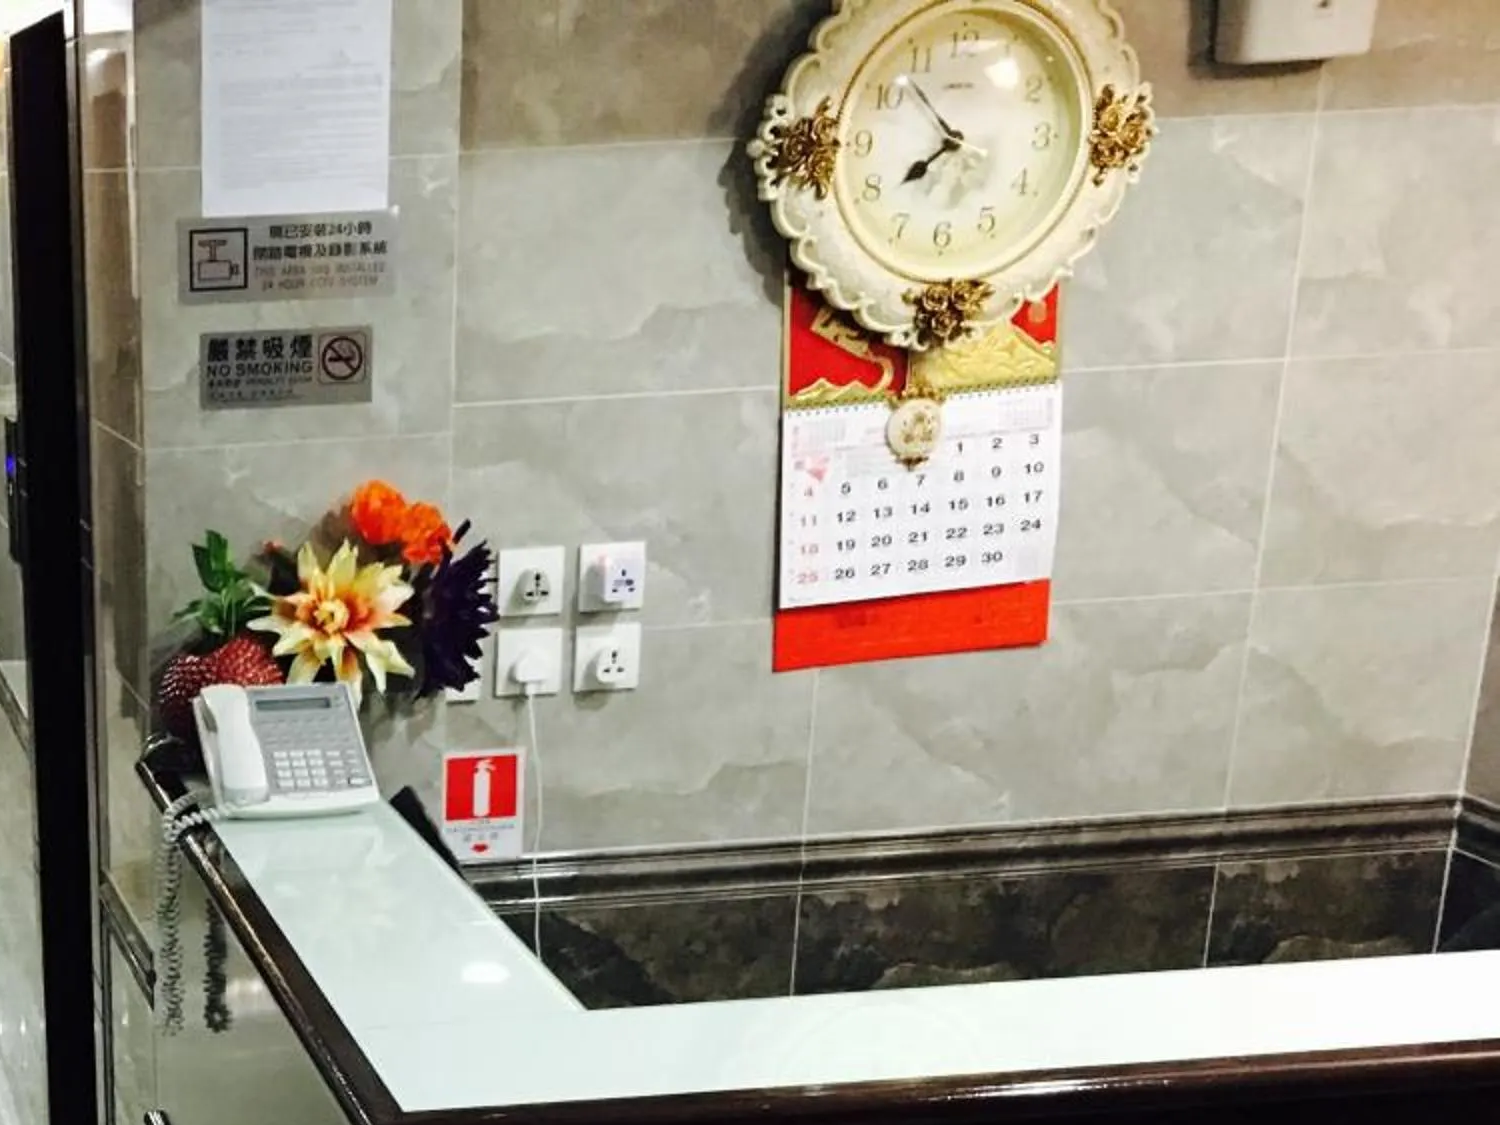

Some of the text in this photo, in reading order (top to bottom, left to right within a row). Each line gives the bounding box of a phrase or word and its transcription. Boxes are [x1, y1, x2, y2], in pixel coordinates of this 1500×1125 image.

[910, 47, 932, 74] 11
[854, 130, 873, 158] 9
[862, 172, 882, 202] 8
[932, 220, 953, 248] 6
[207, 361, 313, 378] NO SMOKING
[958, 433, 1040, 455] 1 2 3
[840, 482, 852, 495] 5
[877, 478, 889, 490] 6
[916, 474, 926, 487] 7
[953, 471, 965, 483] 8
[991, 466, 1002, 479] 9
[1024, 462, 1045, 475] 10
[801, 490, 1043, 526] 11 12 13 14 15 16 17
[837, 539, 856, 552] 19
[871, 535, 893, 548] 20
[908, 531, 928, 544] 21
[945, 527, 968, 541] 22
[983, 523, 1005, 536] 23
[1020, 519, 1042, 532] 24
[835, 567, 855, 581] 26
[870, 563, 892, 577] 27
[907, 559, 929, 572] 28
[944, 555, 967, 569] 29
[981, 551, 1004, 565] 30
